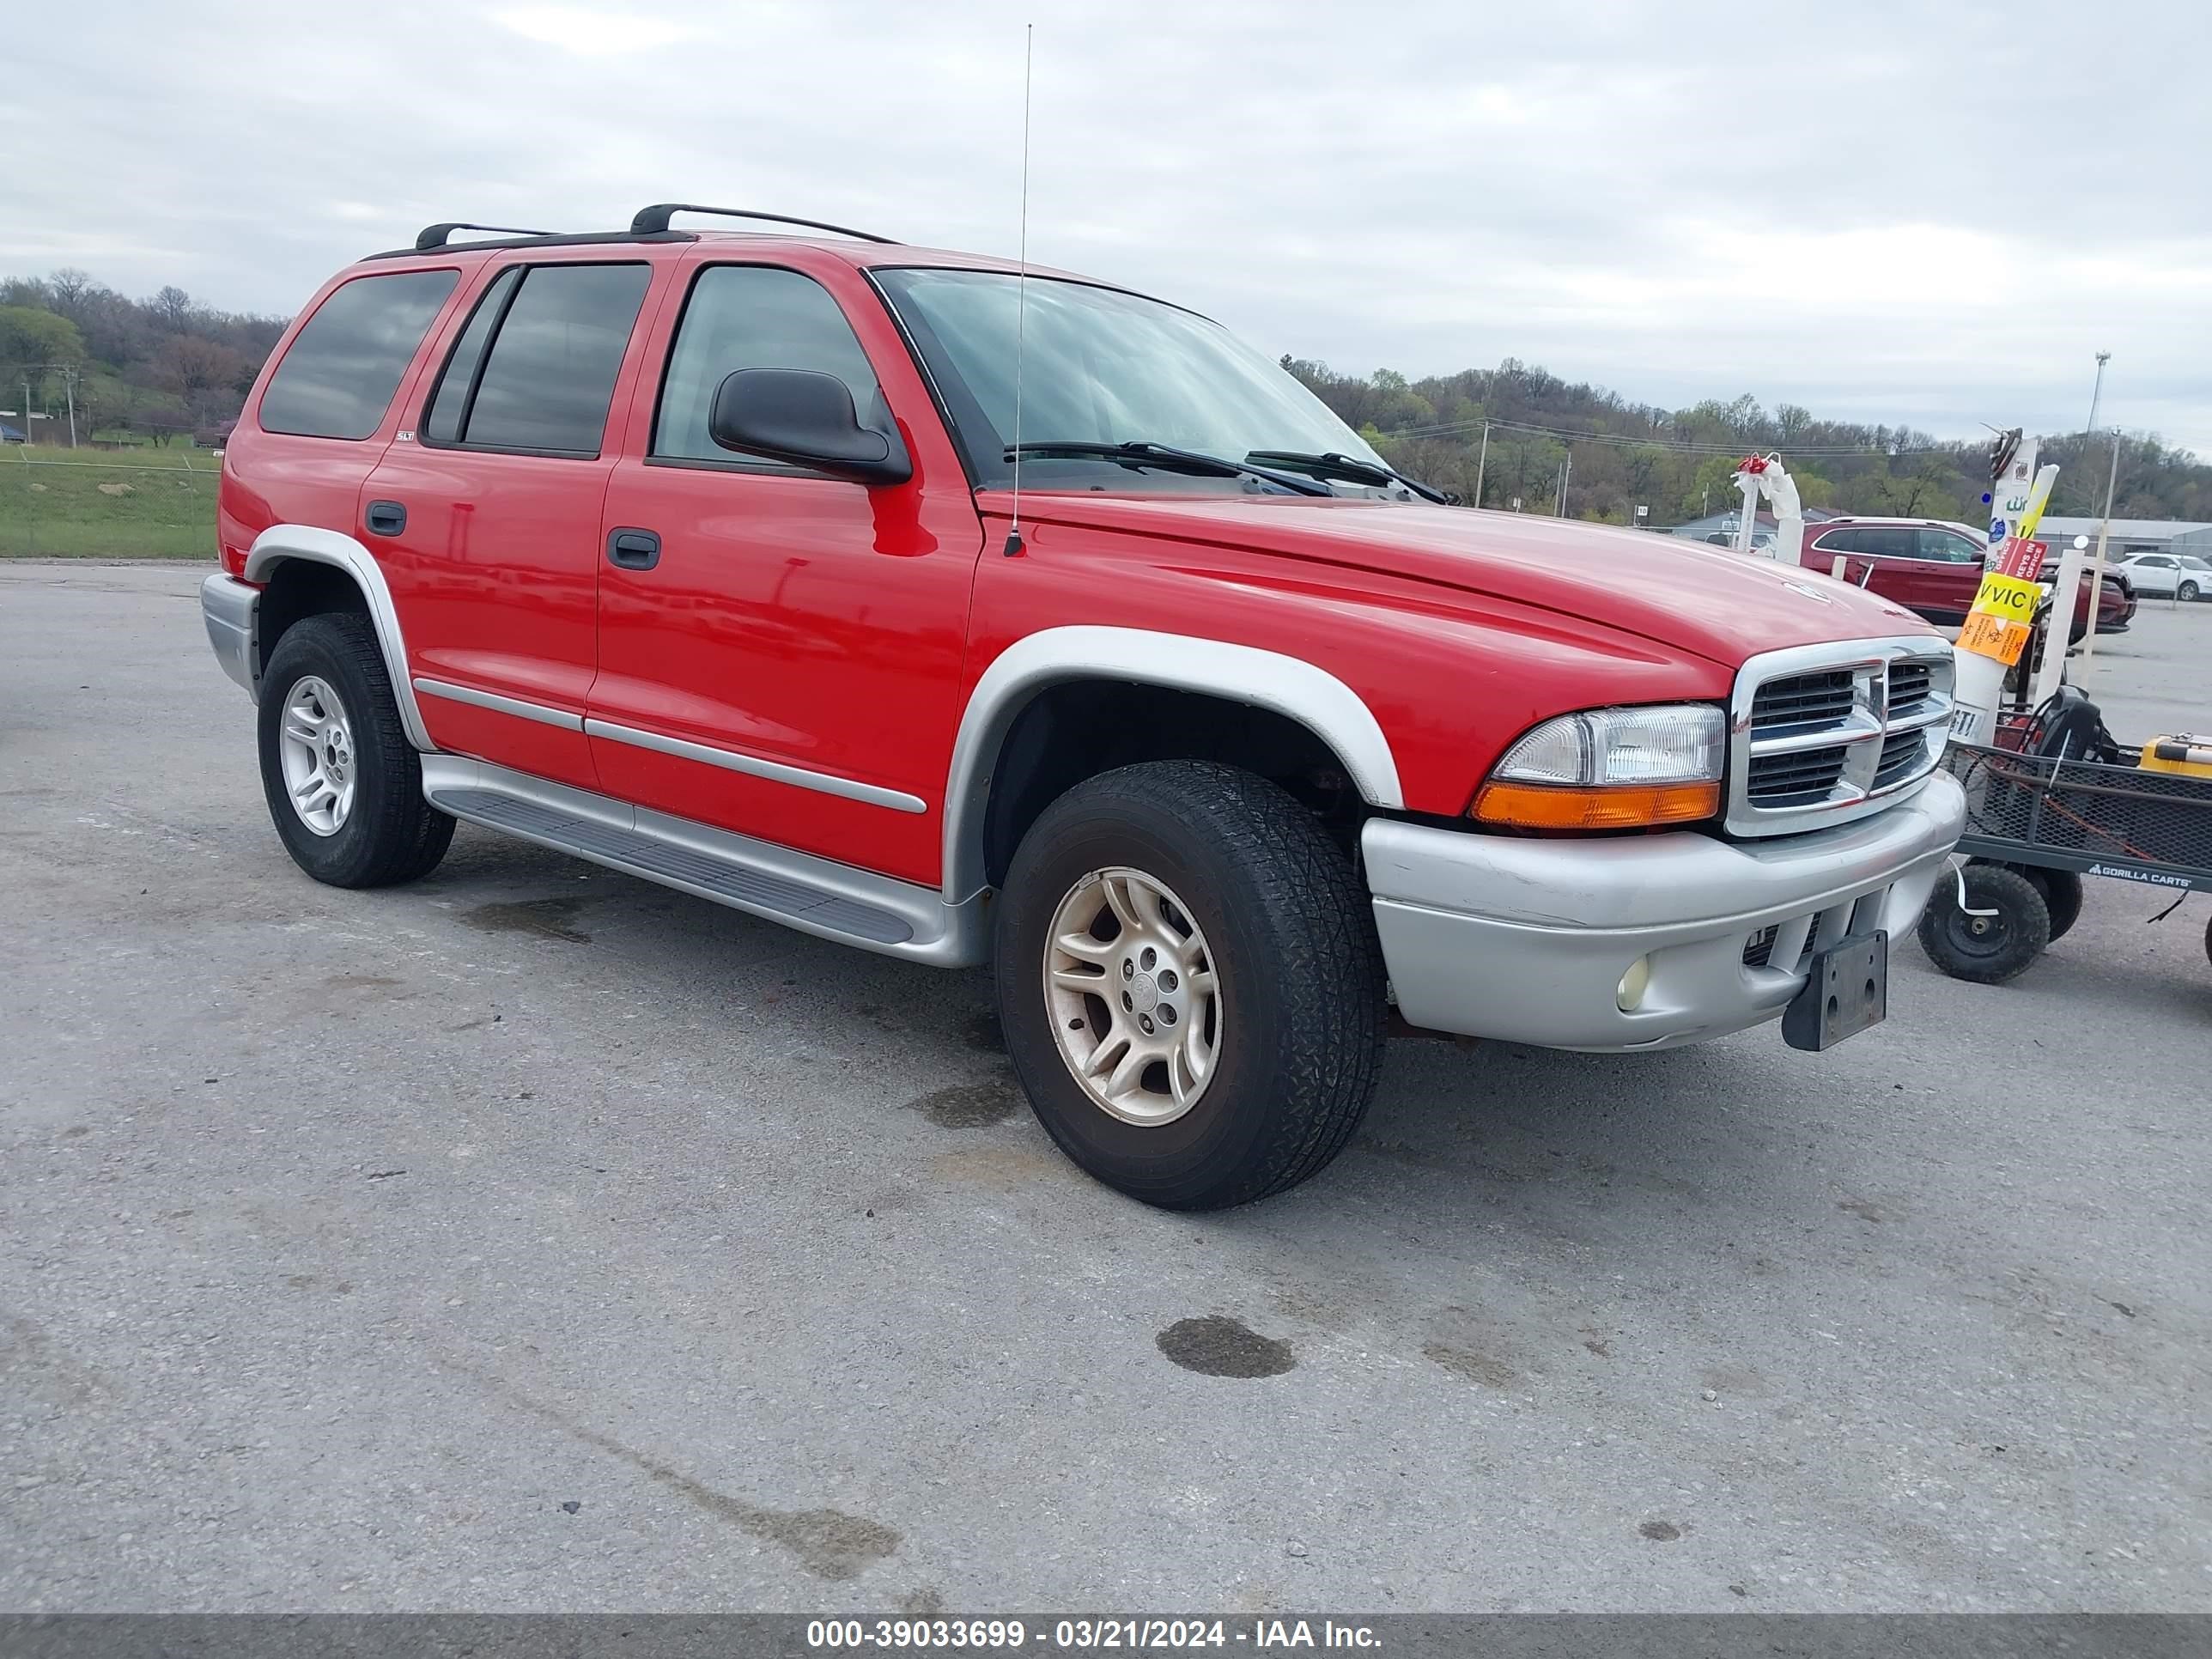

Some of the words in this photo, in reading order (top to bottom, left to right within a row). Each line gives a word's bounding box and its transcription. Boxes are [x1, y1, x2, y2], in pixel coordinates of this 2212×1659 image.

[2015, 554, 2031, 578] KEYS
[2026, 543, 2036, 554] IN
[2026, 547, 2043, 578] OFFICE
[2102, 867, 2148, 882] GORILLA
[2150, 874, 2190, 888] CARTS
